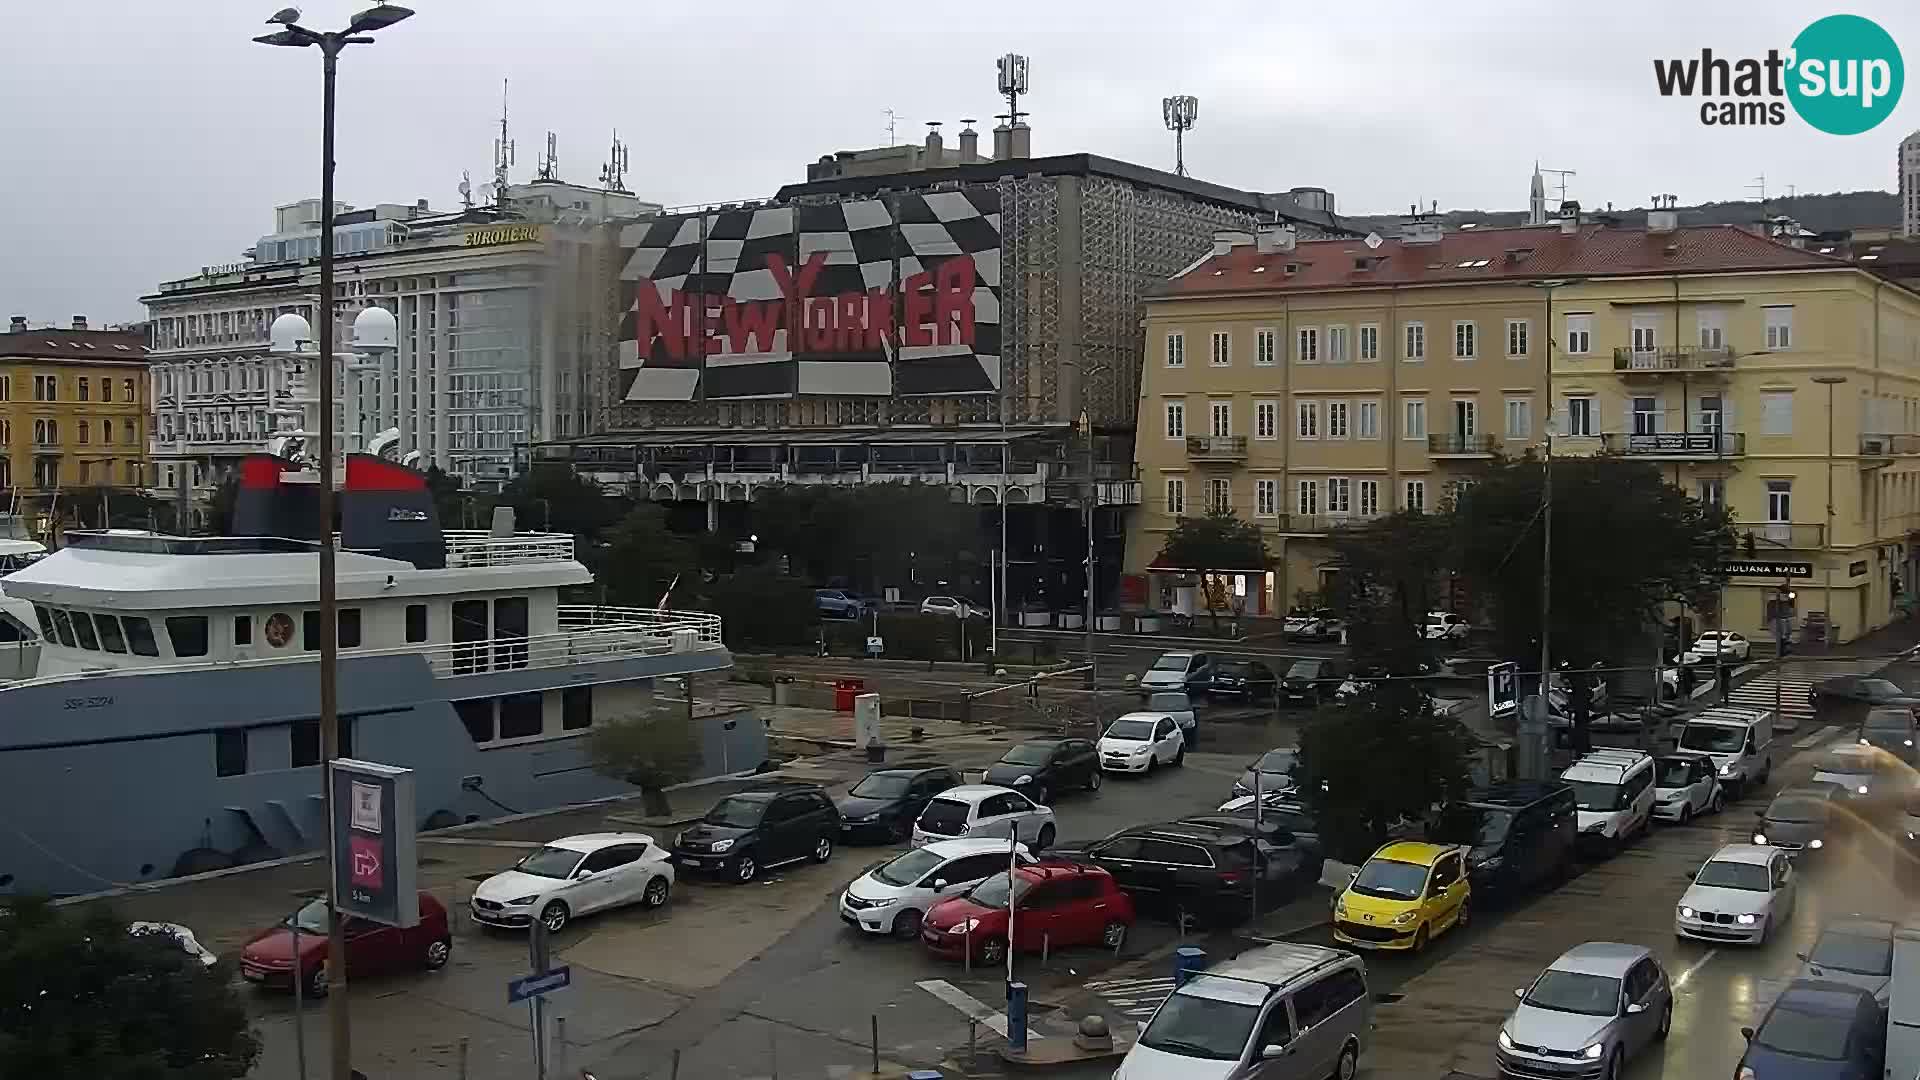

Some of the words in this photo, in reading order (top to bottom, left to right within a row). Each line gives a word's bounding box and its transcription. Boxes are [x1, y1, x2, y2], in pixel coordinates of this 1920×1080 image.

[637, 276, 786, 359] NEW
[766, 250, 977, 352] YORKER
[1725, 564, 1771, 573] JULIANA
[1775, 565, 1807, 574] NAILS
